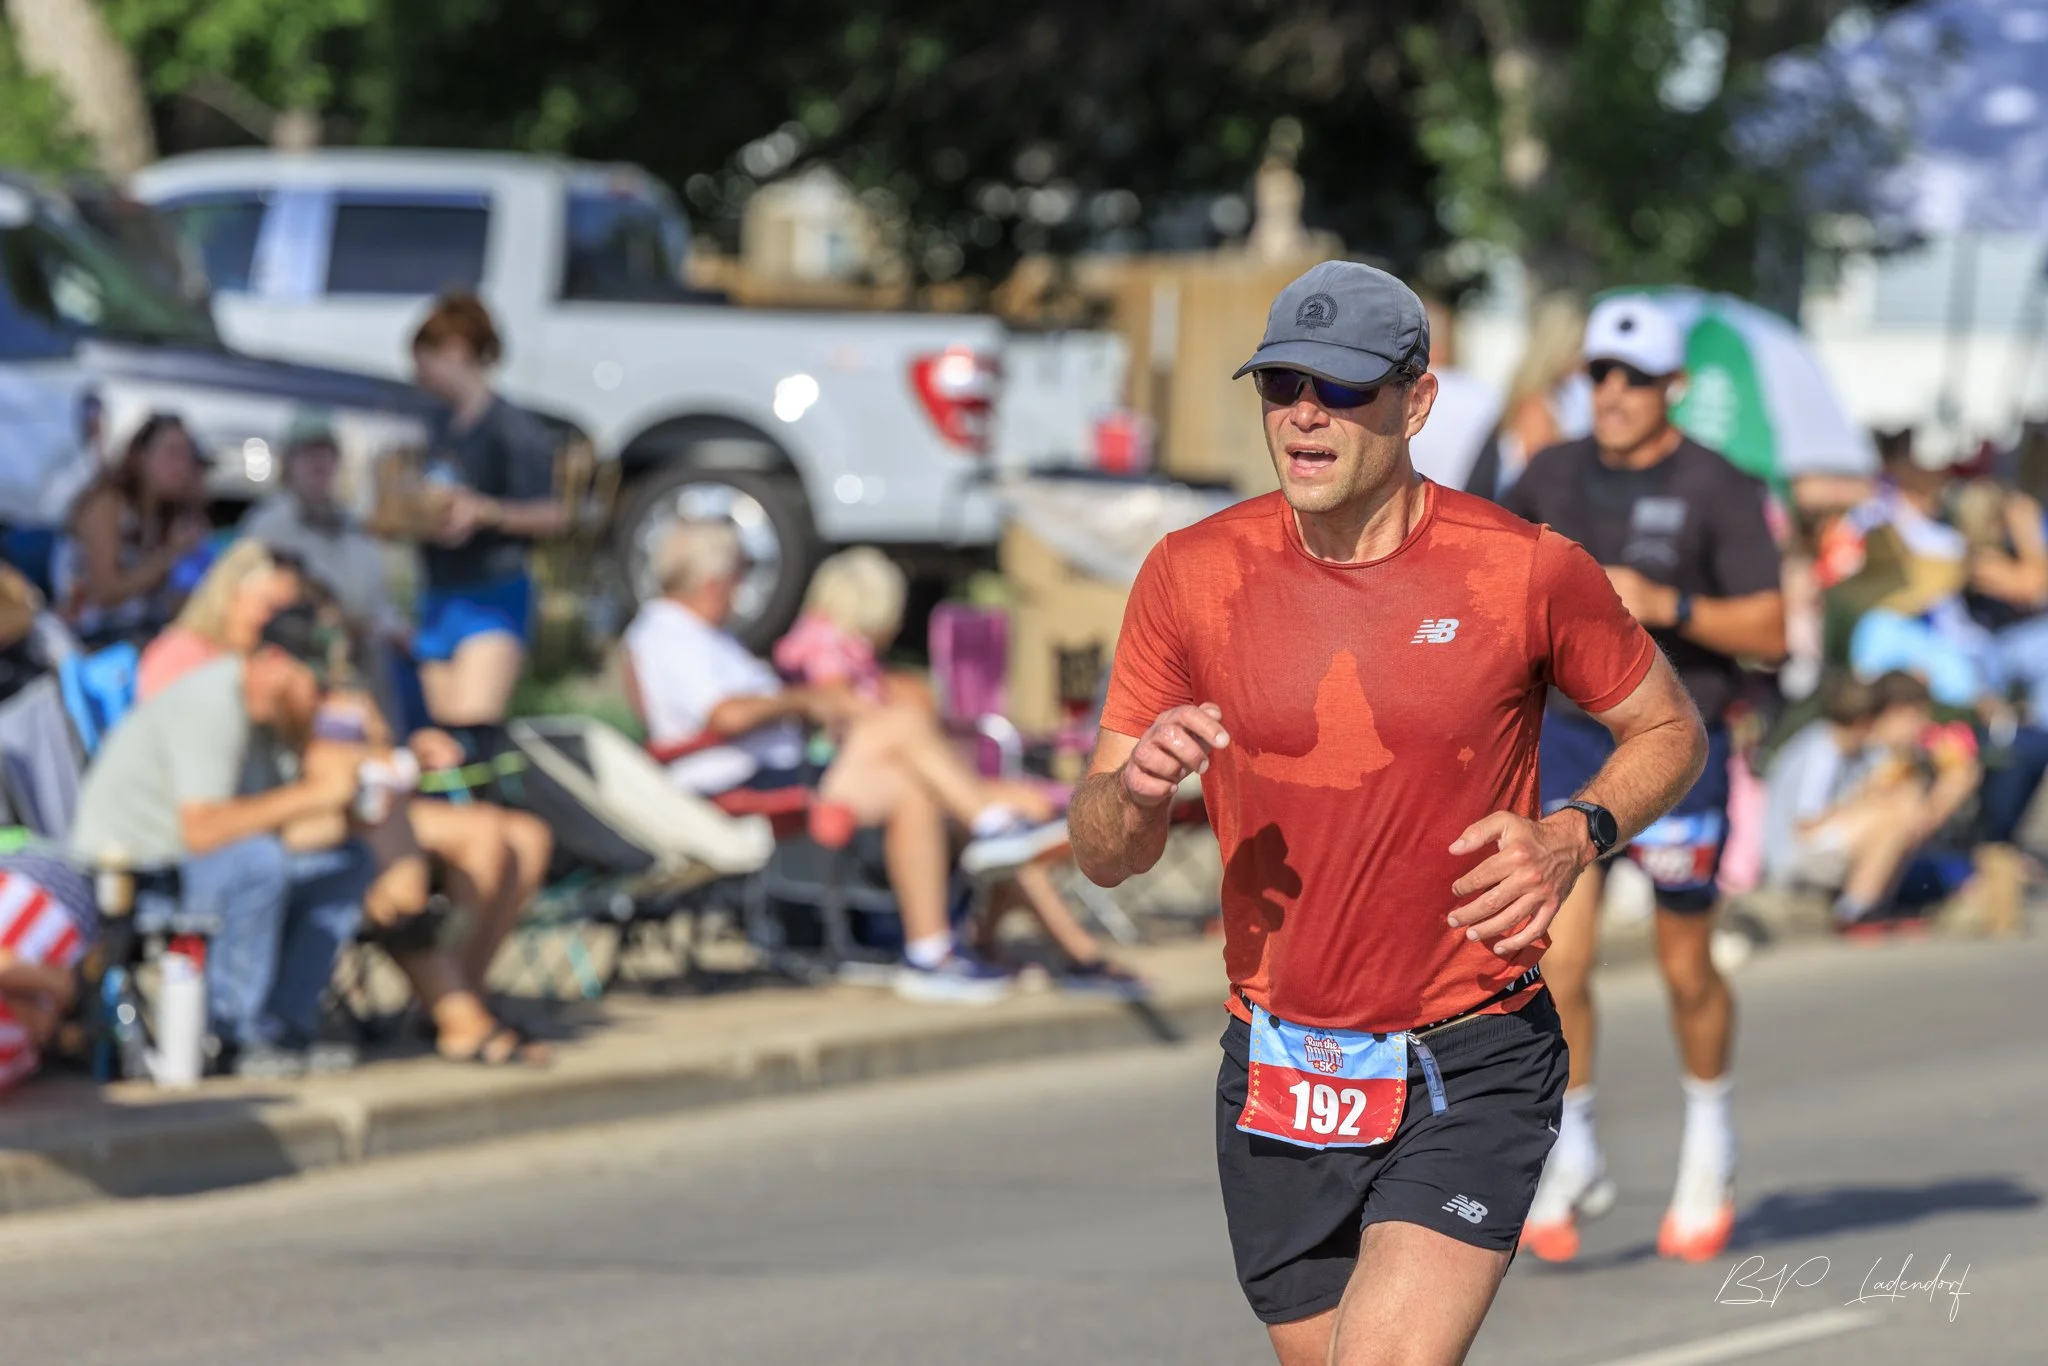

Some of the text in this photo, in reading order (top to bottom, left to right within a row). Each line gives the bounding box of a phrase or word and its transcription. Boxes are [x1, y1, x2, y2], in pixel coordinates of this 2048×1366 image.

[1411, 618, 1460, 644] NB
[1305, 1036, 1337, 1050] Run the
[1305, 1045, 1343, 1068] ROUTE
[1319, 1061, 1334, 1073] 5K
[1289, 1080, 1367, 1136] 192
[1441, 1193, 1489, 1224] NB
